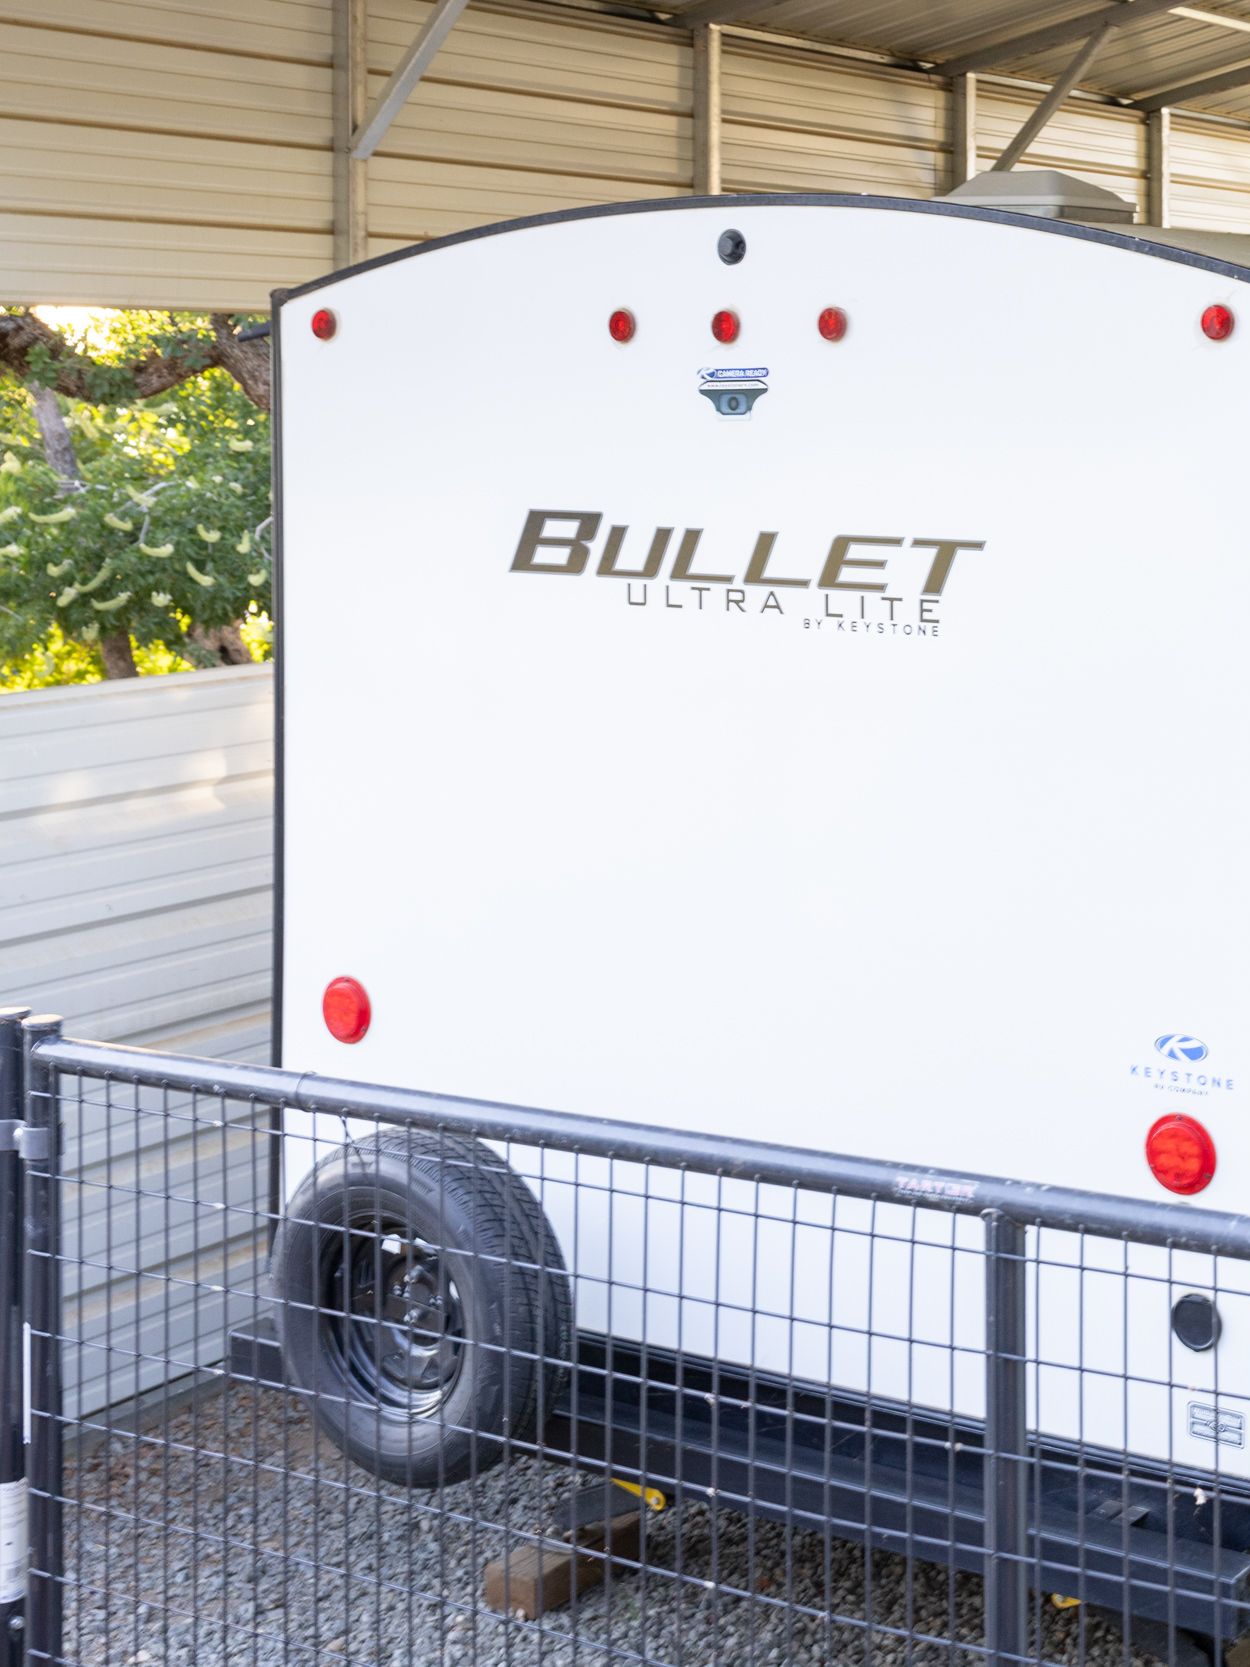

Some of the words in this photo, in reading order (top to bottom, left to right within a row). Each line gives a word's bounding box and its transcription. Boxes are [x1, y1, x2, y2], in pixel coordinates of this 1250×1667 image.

[508, 508, 986, 596] BULLET
[626, 583, 784, 615] ULTRA
[824, 593, 941, 625] LITE
[803, 617, 823, 631] BY
[837, 620, 940, 638] KEYSTONE
[1129, 1063, 1235, 1091] KEYSTONE
